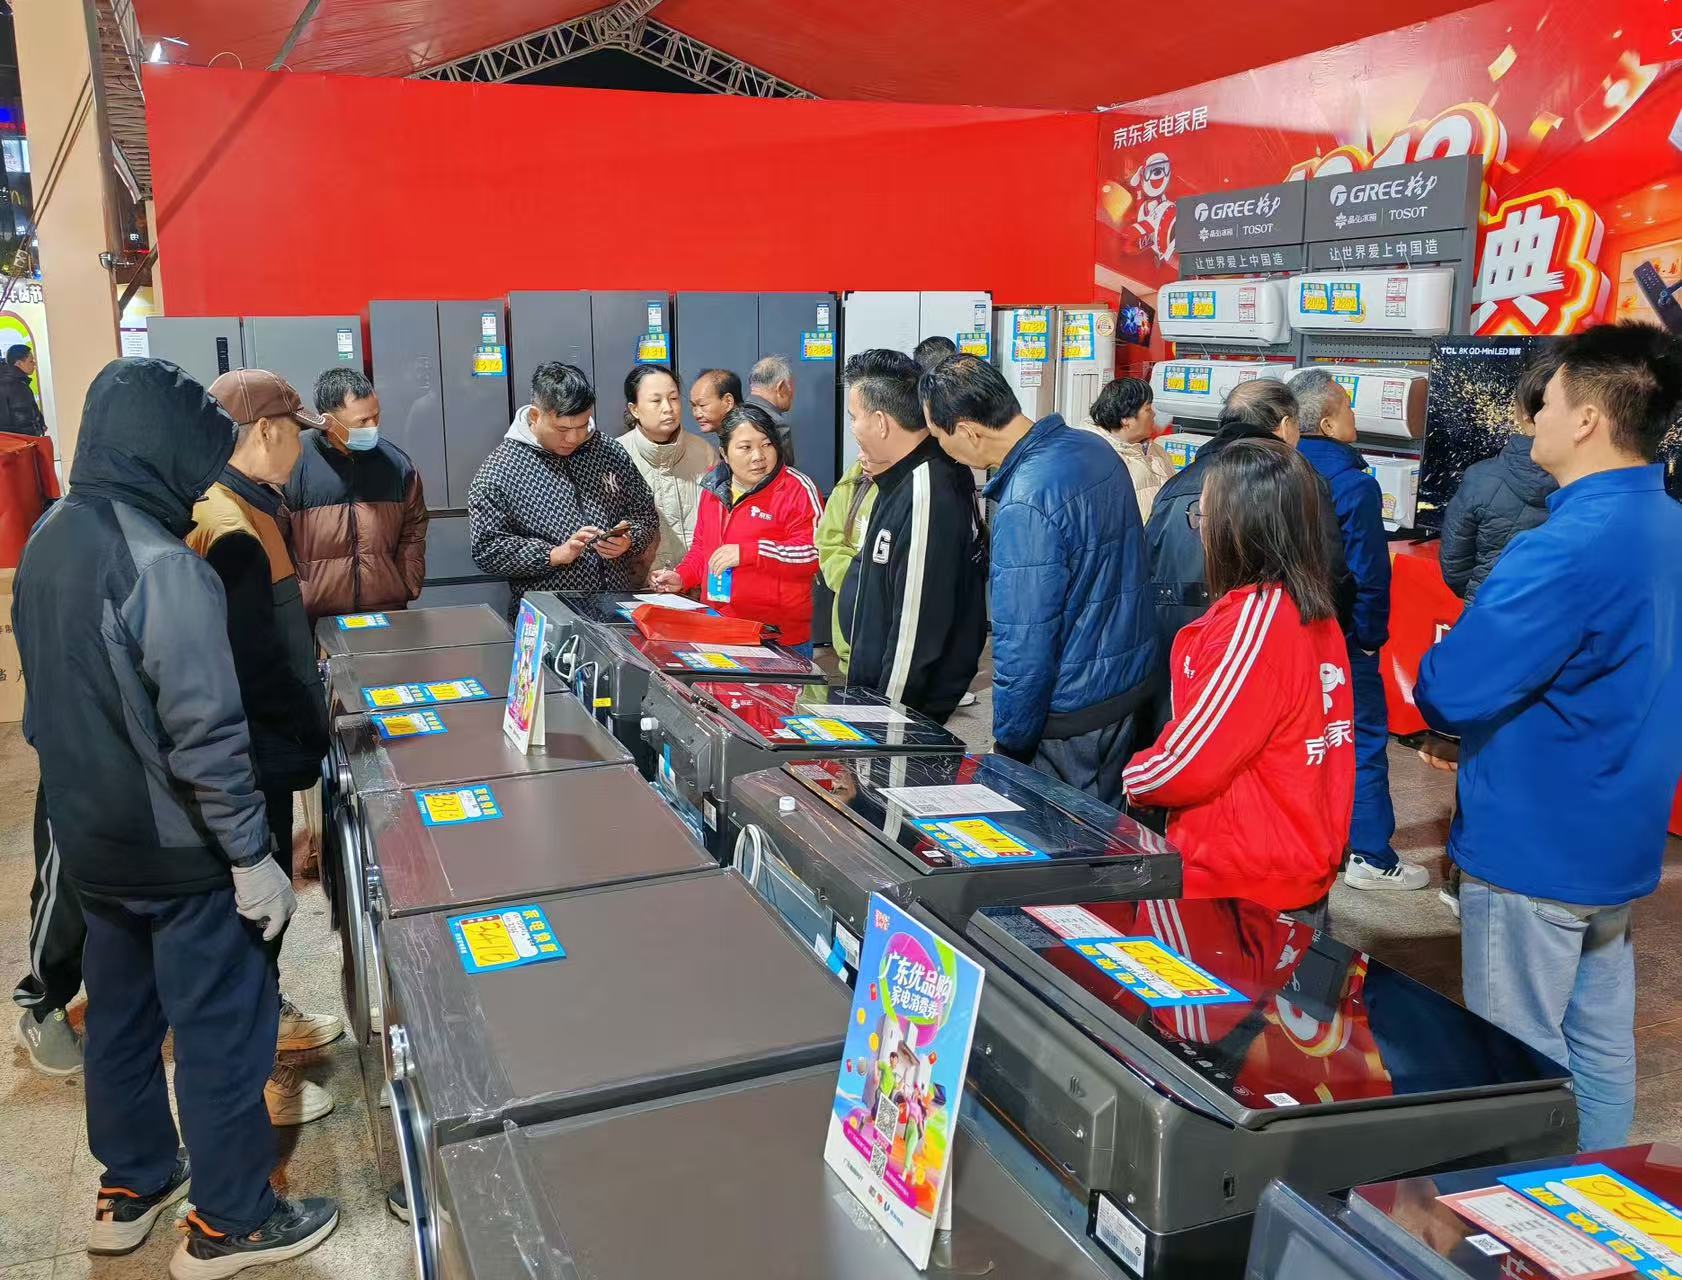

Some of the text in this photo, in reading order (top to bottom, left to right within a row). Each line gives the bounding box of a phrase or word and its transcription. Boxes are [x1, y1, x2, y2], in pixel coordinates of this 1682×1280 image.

[1113, 105, 1208, 150] 京东家电家居
[1350, 180, 1405, 204] GREE
[1210, 199, 1255, 220] GREE
[1389, 206, 1428, 221] TOSOT
[1242, 223, 1274, 236] TOSOT
[1194, 252, 1285, 270] 让世界爱上中国造
[1329, 238, 1439, 261] 让世界爱上中国造
[1470, 203, 1565, 336] 典
[1440, 347, 1457, 355] TCL
[878, 951, 954, 1003] 广东优品购
[889, 985, 942, 1020] 家电消费券
